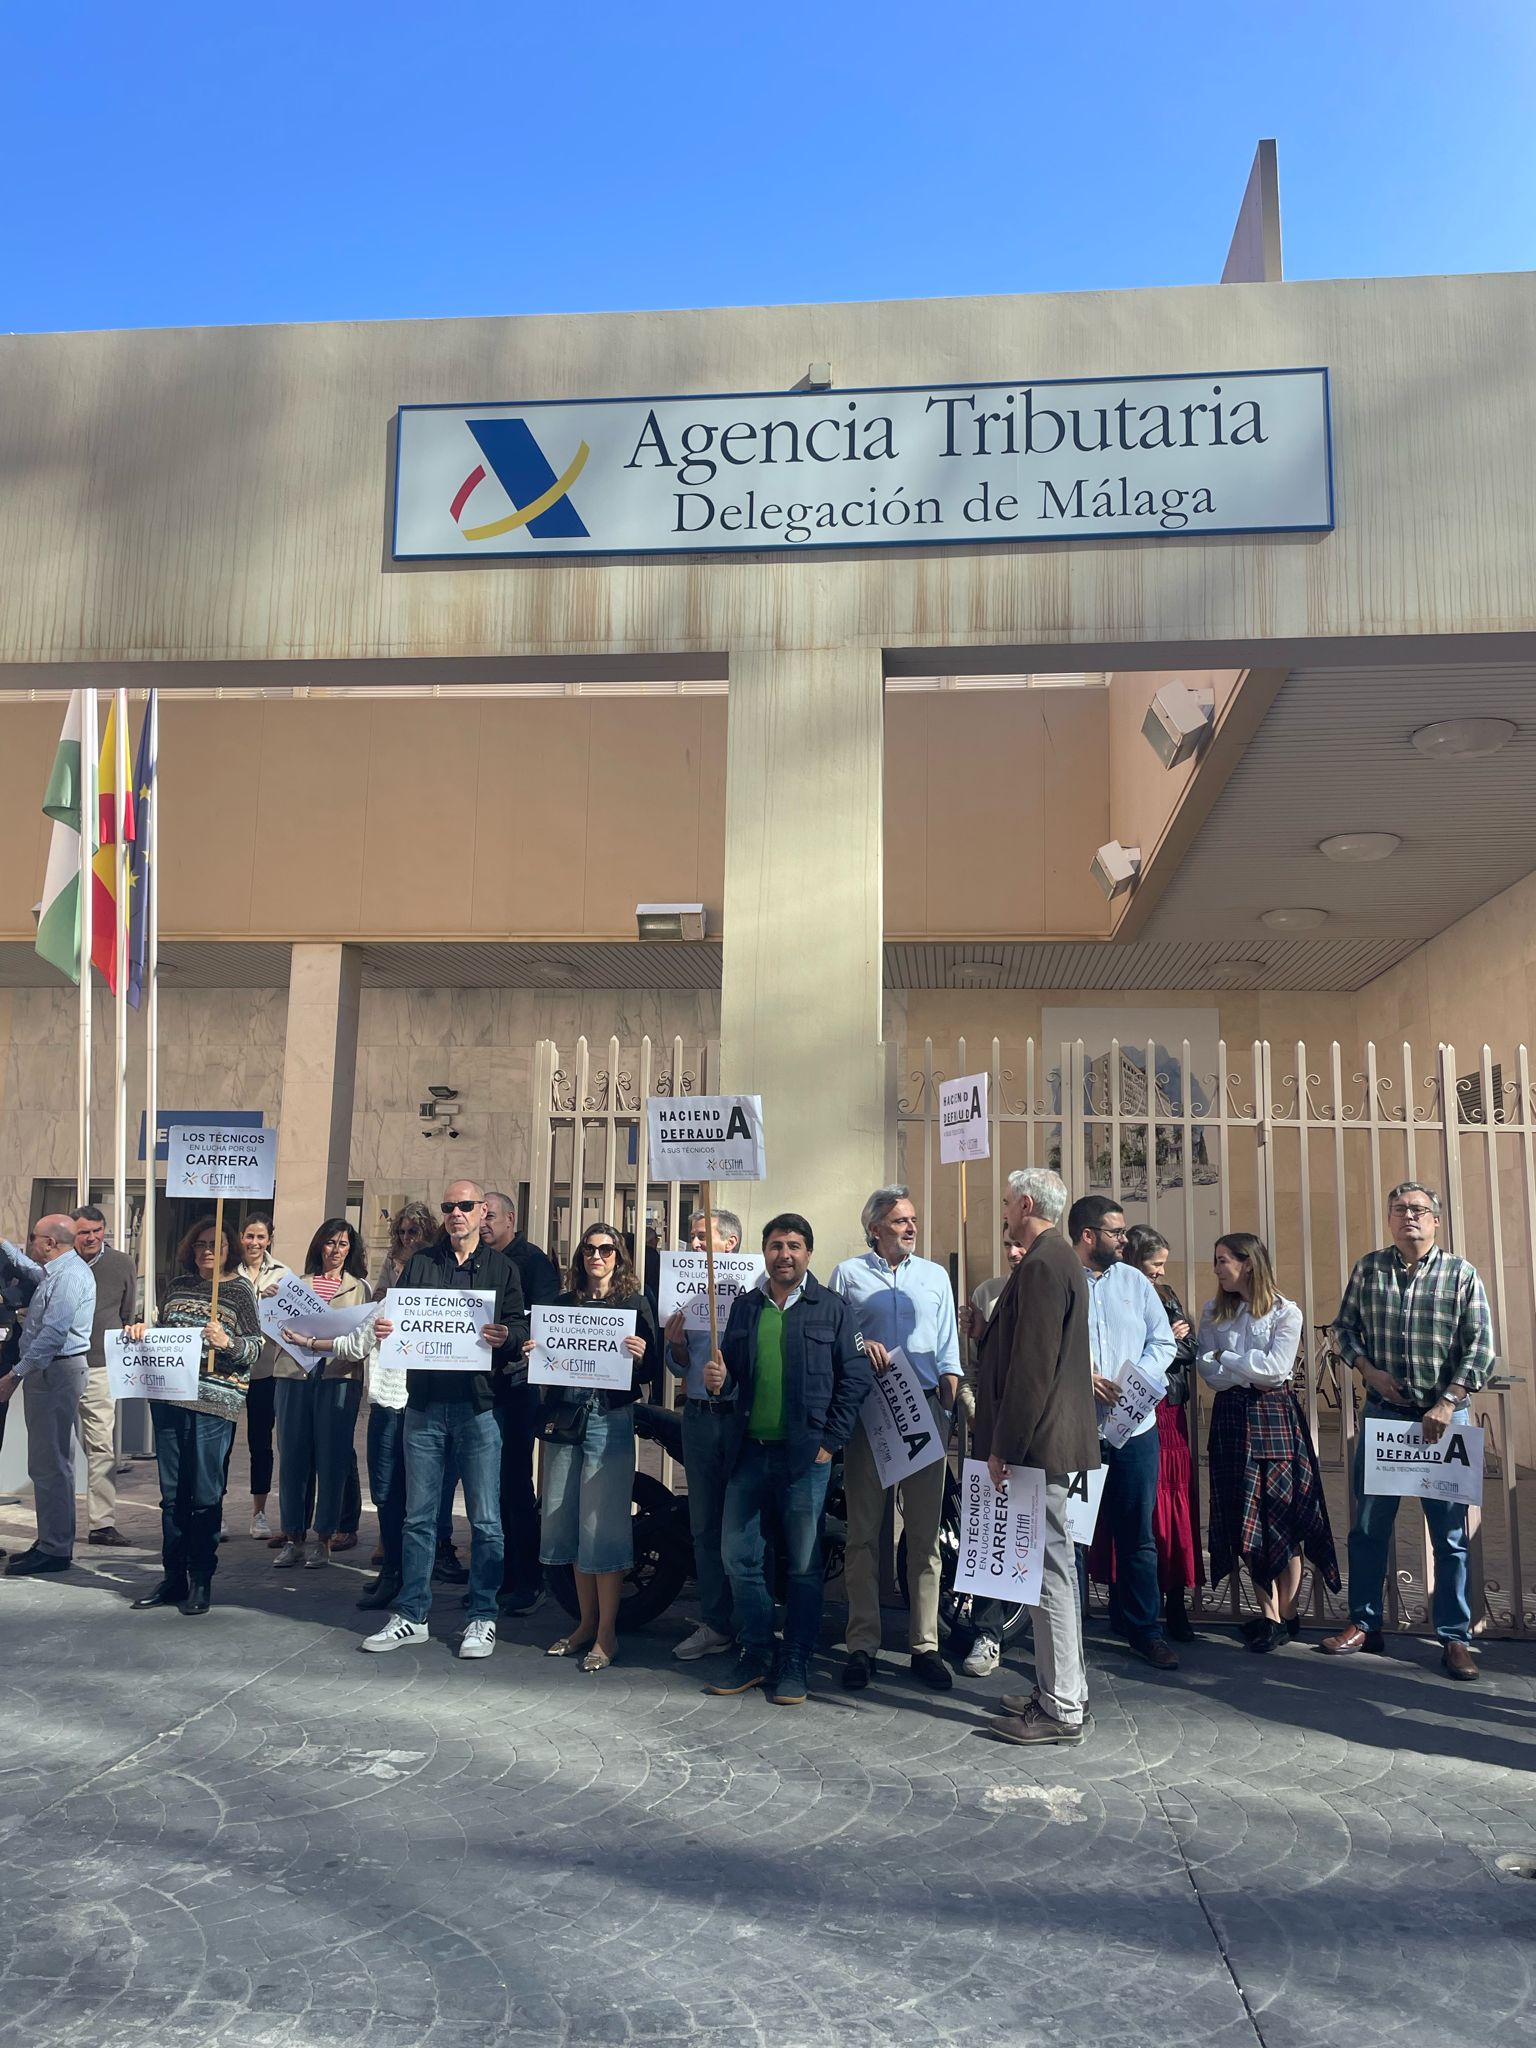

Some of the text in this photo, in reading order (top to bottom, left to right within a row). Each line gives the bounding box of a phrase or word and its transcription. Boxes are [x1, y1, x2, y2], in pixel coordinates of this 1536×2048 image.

[623, 386, 1269, 485] Agencia Tributaria
[671, 477, 1217, 543] Delegación de Málaga
[182, 1131, 265, 1144] LOS TÉCNICOS
[185, 1154, 258, 1167] CARRERA
[719, 1158, 743, 1170] GESTHA
[201, 1173, 236, 1185] GESTHA
[672, 1259, 694, 1269] LOS
[691, 1271, 716, 1279] LUC
[735, 1273, 746, 1281] SU
[287, 1281, 326, 1313] LOS TÉCN
[398, 1295, 483, 1308] LOS TÉCNICOS
[277, 1298, 304, 1317] CAR
[417, 1309, 443, 1317] LUCHA
[691, 1303, 726, 1316] GESHA
[542, 1313, 624, 1326] LOS TÉCNICOS
[400, 1320, 476, 1334] CARRERA
[562, 1327, 586, 1335] LUCHA
[138, 1332, 192, 1344] ÉCNICOS
[546, 1337, 618, 1352] CARRERA
[416, 1341, 452, 1355] GESTHA
[122, 1356, 184, 1367] CARRERA
[561, 1359, 596, 1373] GESTHA
[1127, 1374, 1147, 1397] LOS
[1127, 1389, 1136, 1400] EN
[964, 1474, 980, 1578] LOS TÉCNICOS
[979, 1485, 991, 1570] EN LUCHA POR SU
[990, 1484, 1009, 1576] CARRERA
[1015, 1513, 1031, 1559] GESTHA
